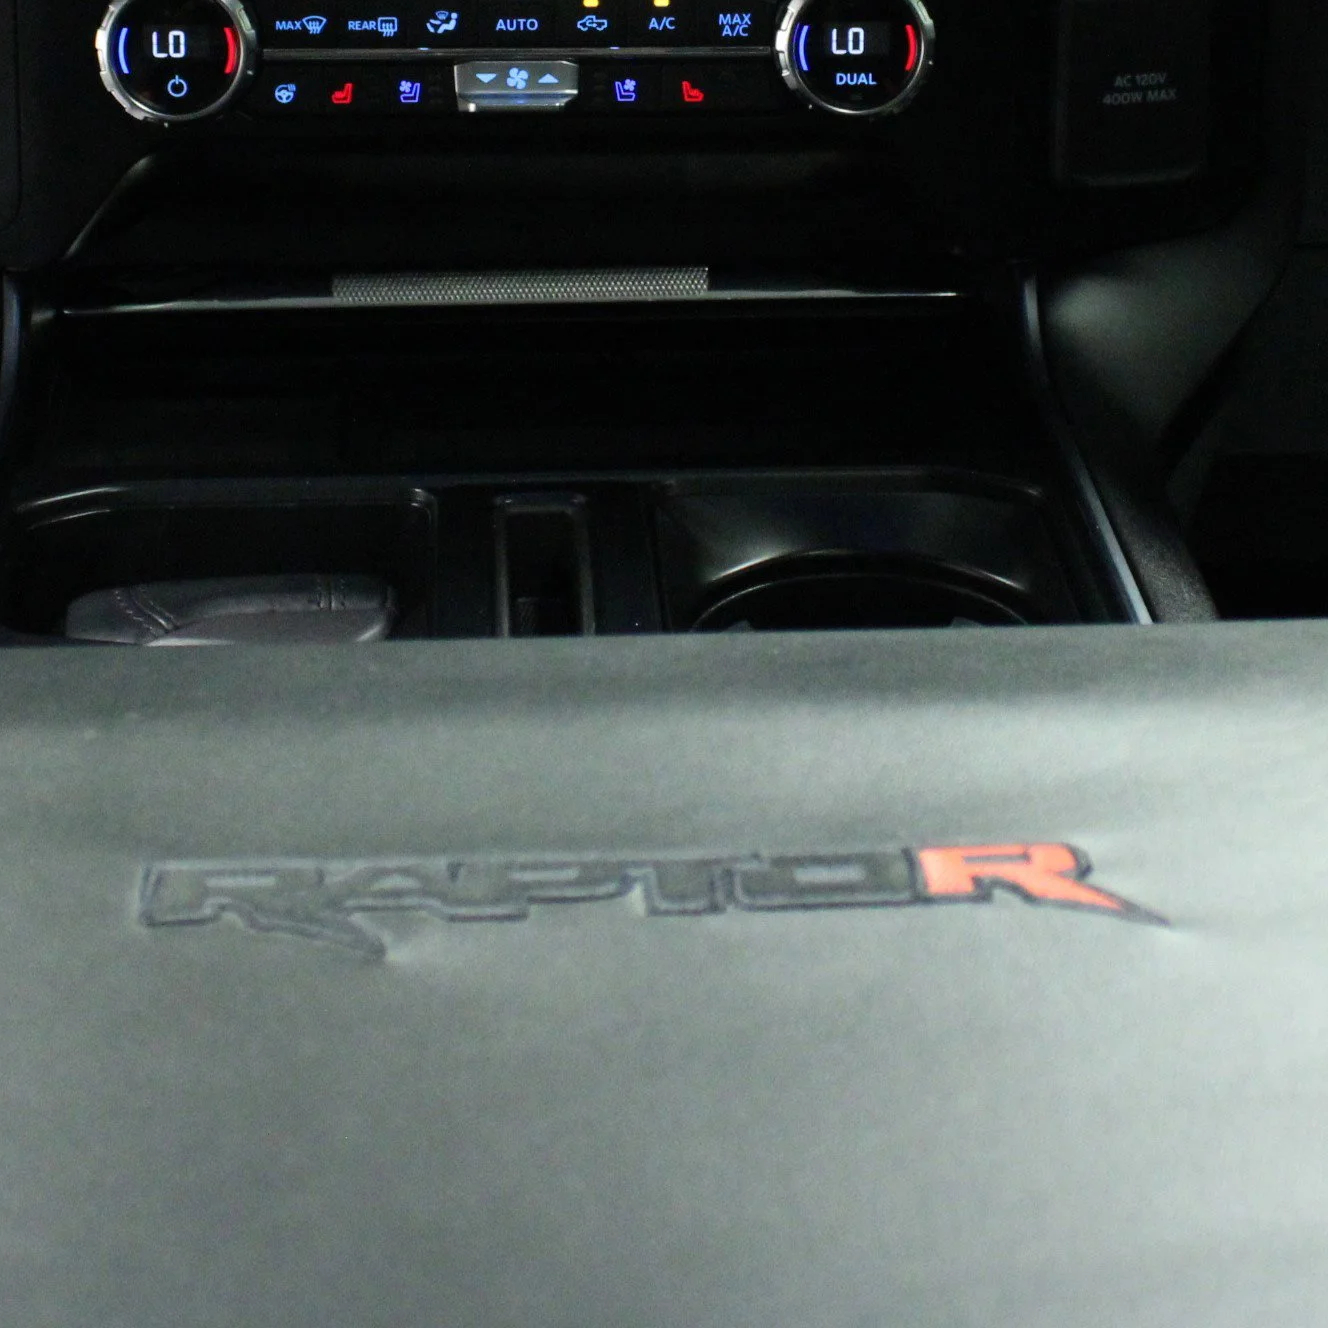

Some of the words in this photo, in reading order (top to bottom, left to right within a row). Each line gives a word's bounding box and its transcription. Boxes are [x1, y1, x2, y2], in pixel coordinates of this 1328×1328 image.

[347, 20, 377, 31] REAR
[495, 18, 539, 31] AUTO
[648, 16, 676, 31] A/C
[718, 13, 752, 25] MAX
[275, 20, 303, 32] MAX
[721, 24, 750, 37] A/C
[835, 71, 878, 87] DUAL
[137, 840, 1175, 964] RAPTOR
